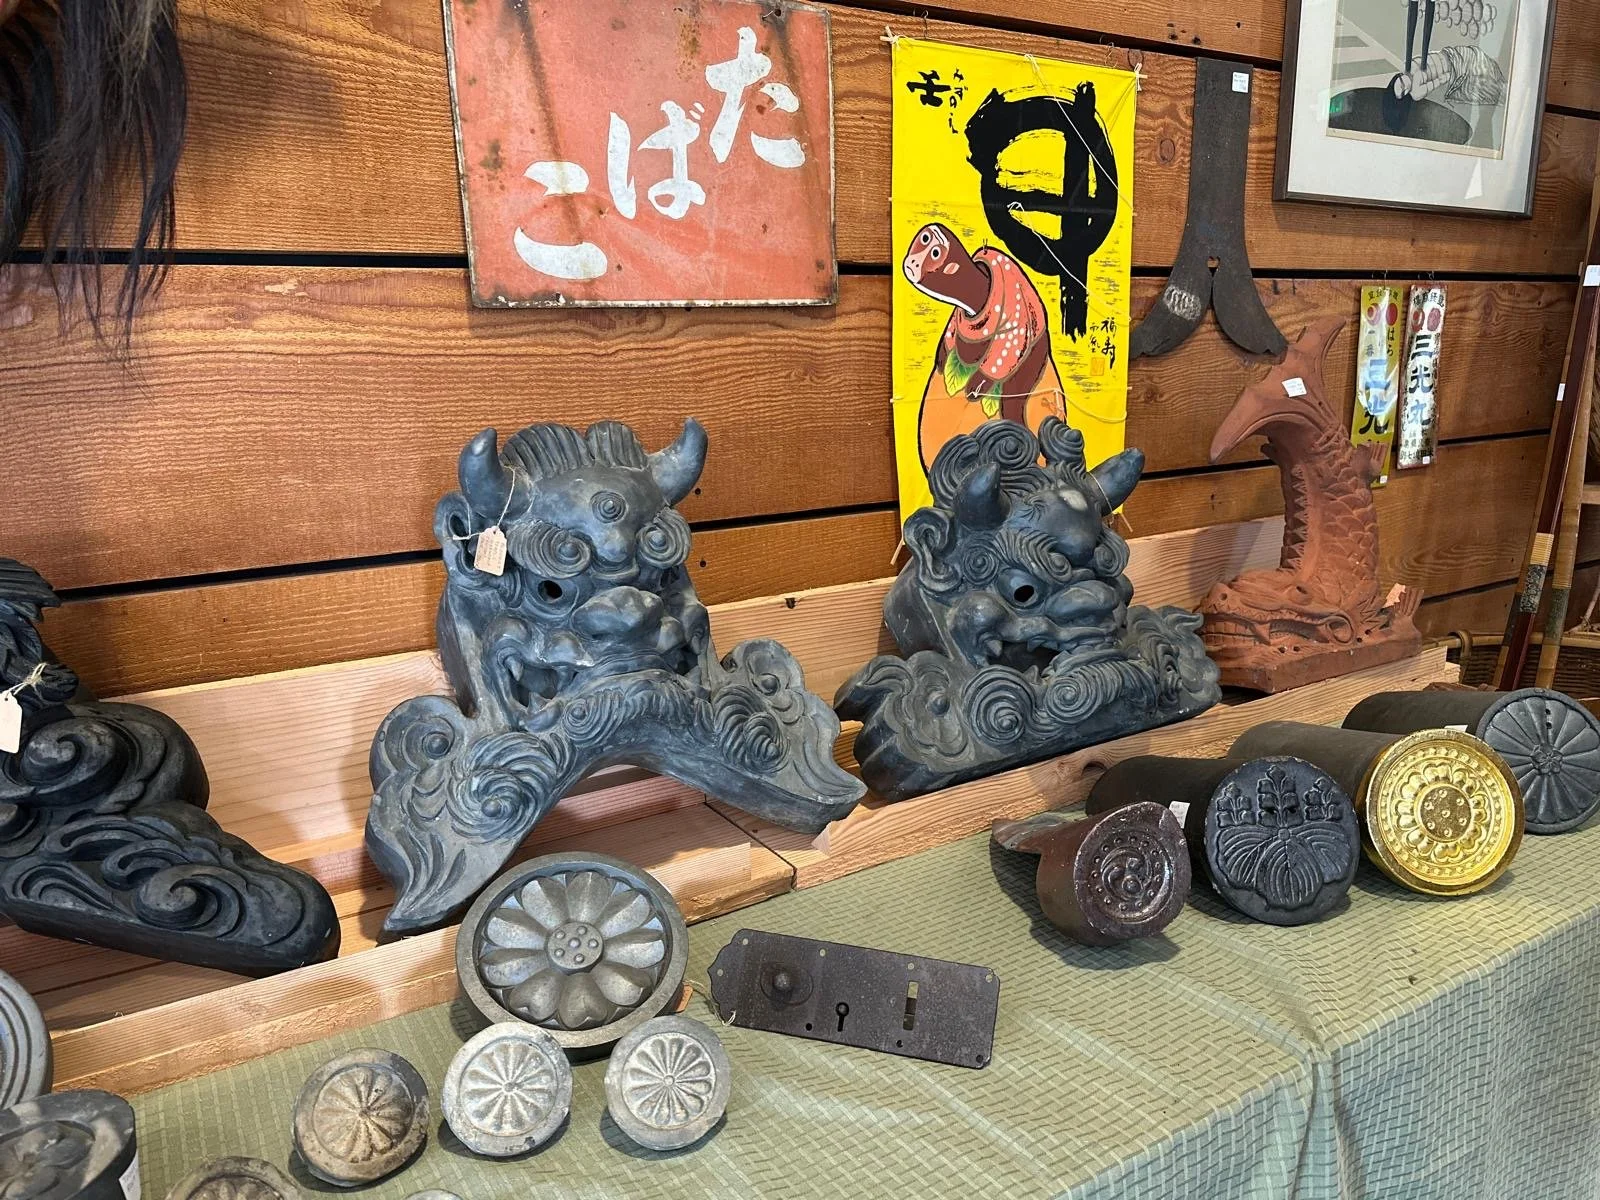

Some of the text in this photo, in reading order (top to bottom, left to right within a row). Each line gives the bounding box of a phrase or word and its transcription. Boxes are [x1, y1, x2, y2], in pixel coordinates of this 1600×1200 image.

[513, 26, 805, 280] たばこ
[906, 70, 951, 107] 壬
[964, 80, 1119, 344] 申
[1408, 334, 1434, 427] 三光丸
